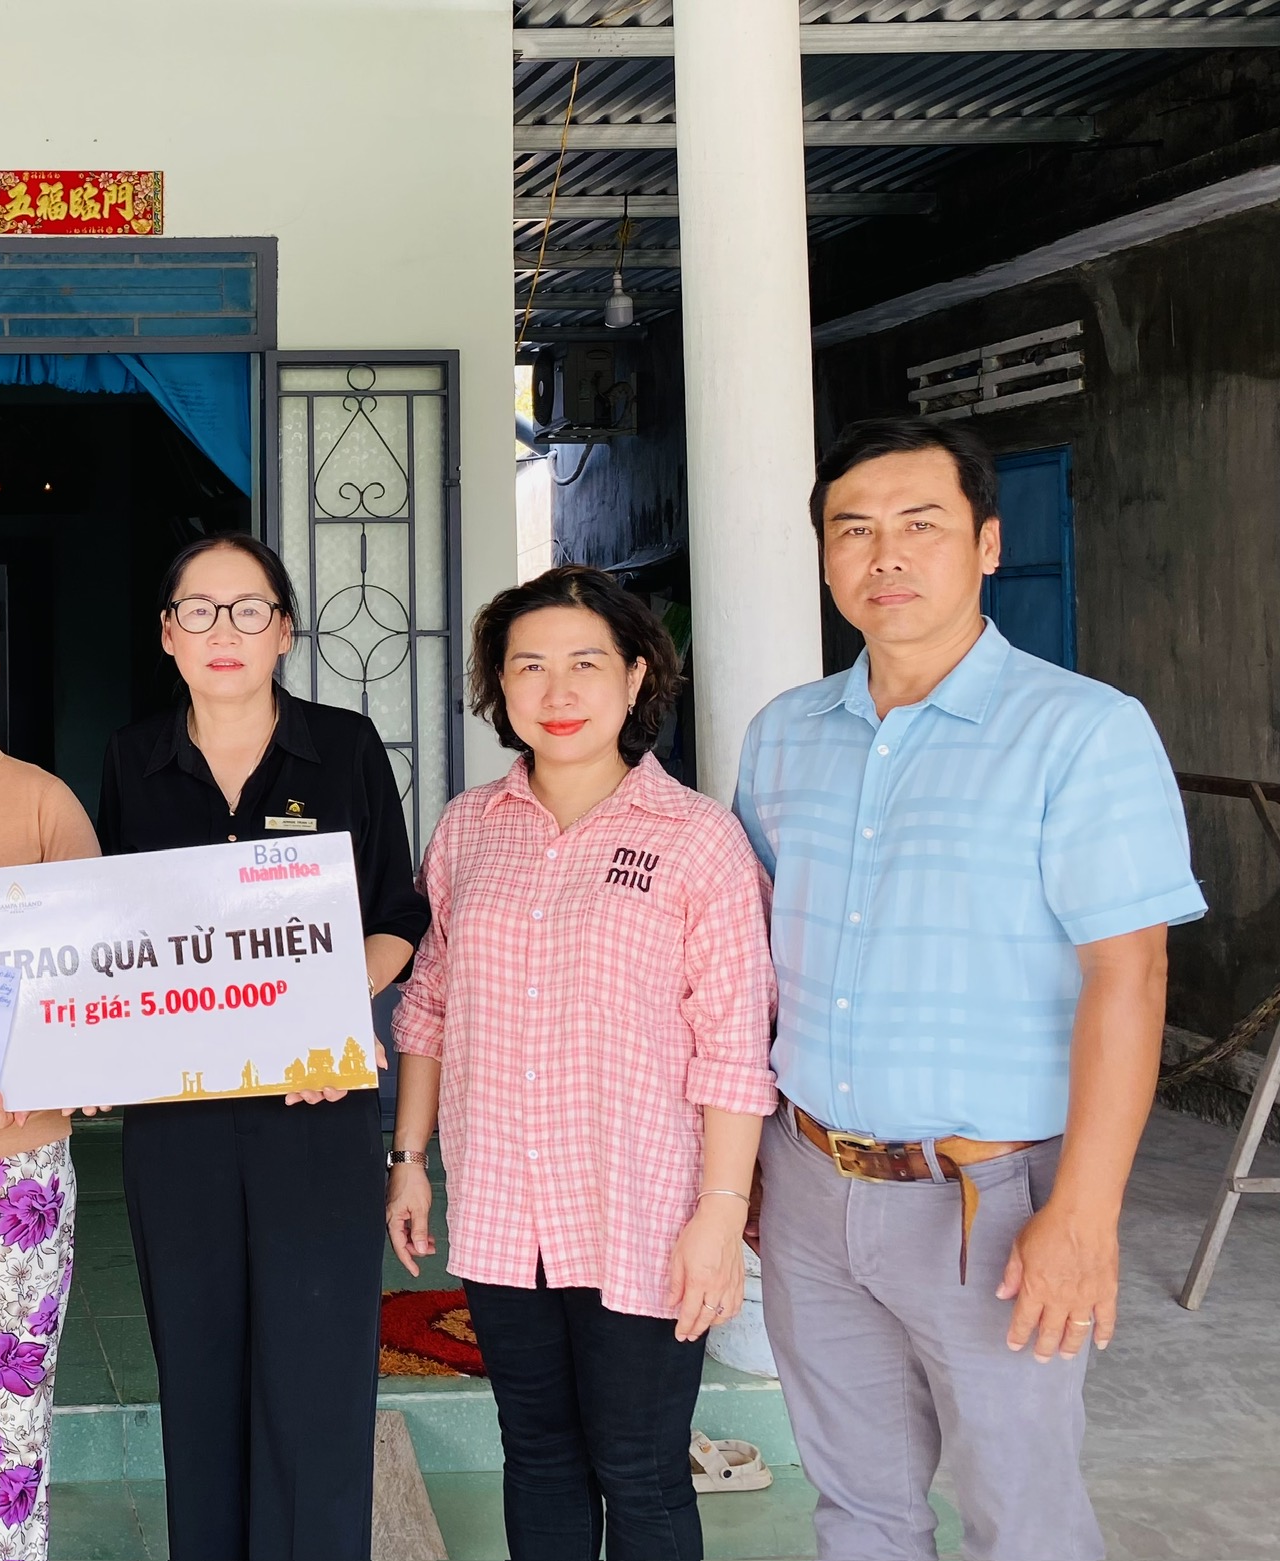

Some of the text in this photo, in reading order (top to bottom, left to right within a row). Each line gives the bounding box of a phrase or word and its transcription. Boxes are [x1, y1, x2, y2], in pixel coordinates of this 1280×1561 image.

[3, 181, 135, 222] 五福臨門
[253, 841, 298, 865] Báo
[90, 930, 158, 978] QUÀ
[168, 924, 216, 965] TỪ
[226, 916, 333, 964] THIỆN
[39, 997, 76, 1028] Trị
[84, 994, 131, 1026] giá:
